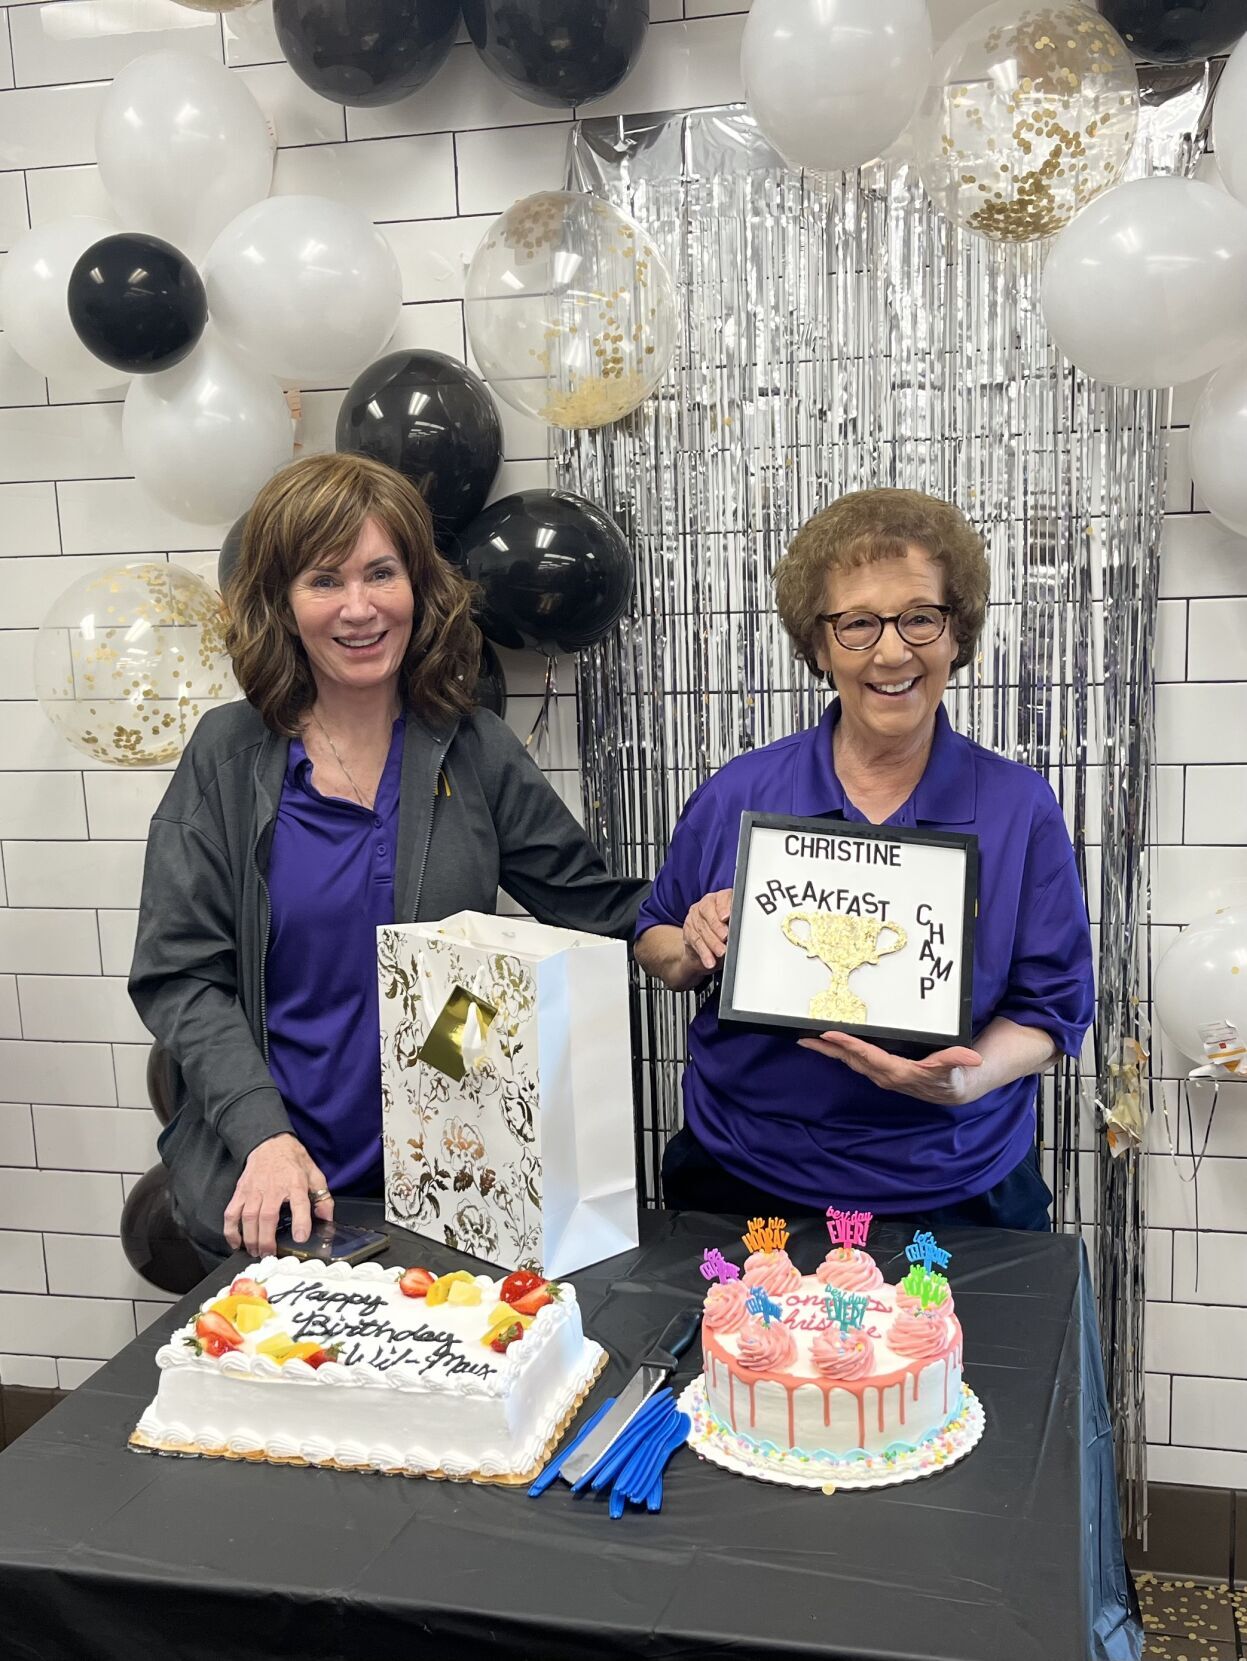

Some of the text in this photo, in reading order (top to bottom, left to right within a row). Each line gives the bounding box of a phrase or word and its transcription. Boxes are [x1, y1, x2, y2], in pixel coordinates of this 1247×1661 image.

[785, 834, 902, 867] CHRISTINE
[755, 879, 890, 921] BREAKFAST
[916, 904, 954, 1000] CHAMP
[268, 1281, 388, 1316] Happy
[292, 1311, 463, 1354] Birthday
